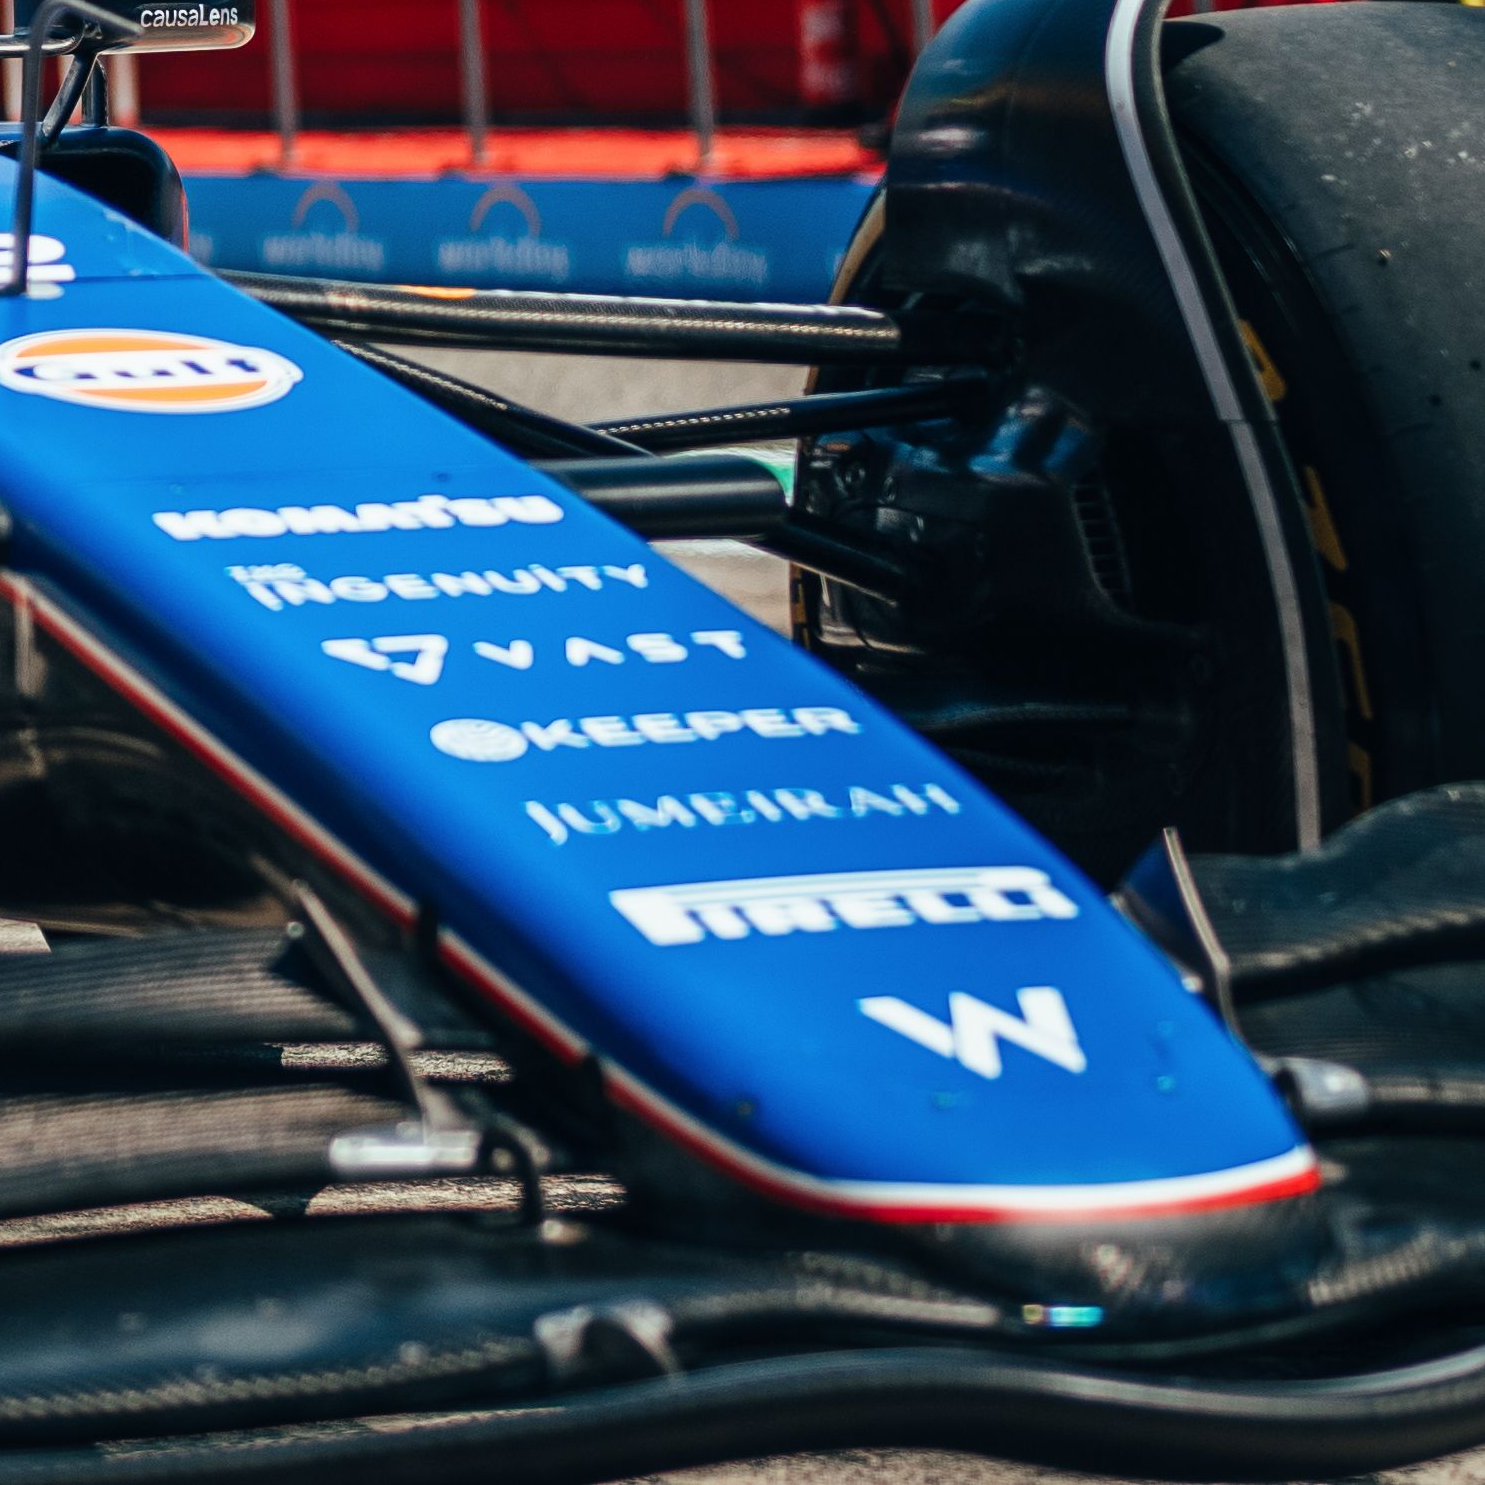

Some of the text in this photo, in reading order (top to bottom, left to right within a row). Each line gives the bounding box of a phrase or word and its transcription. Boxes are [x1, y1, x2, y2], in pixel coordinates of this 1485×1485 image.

[140, 3, 238, 28] causaLens
[473, 629, 748, 670] VAST
[520, 706, 861, 751] KEEPER
[525, 782, 961, 846] JUMEIRAH
[609, 865, 1079, 946] PIRELLI
